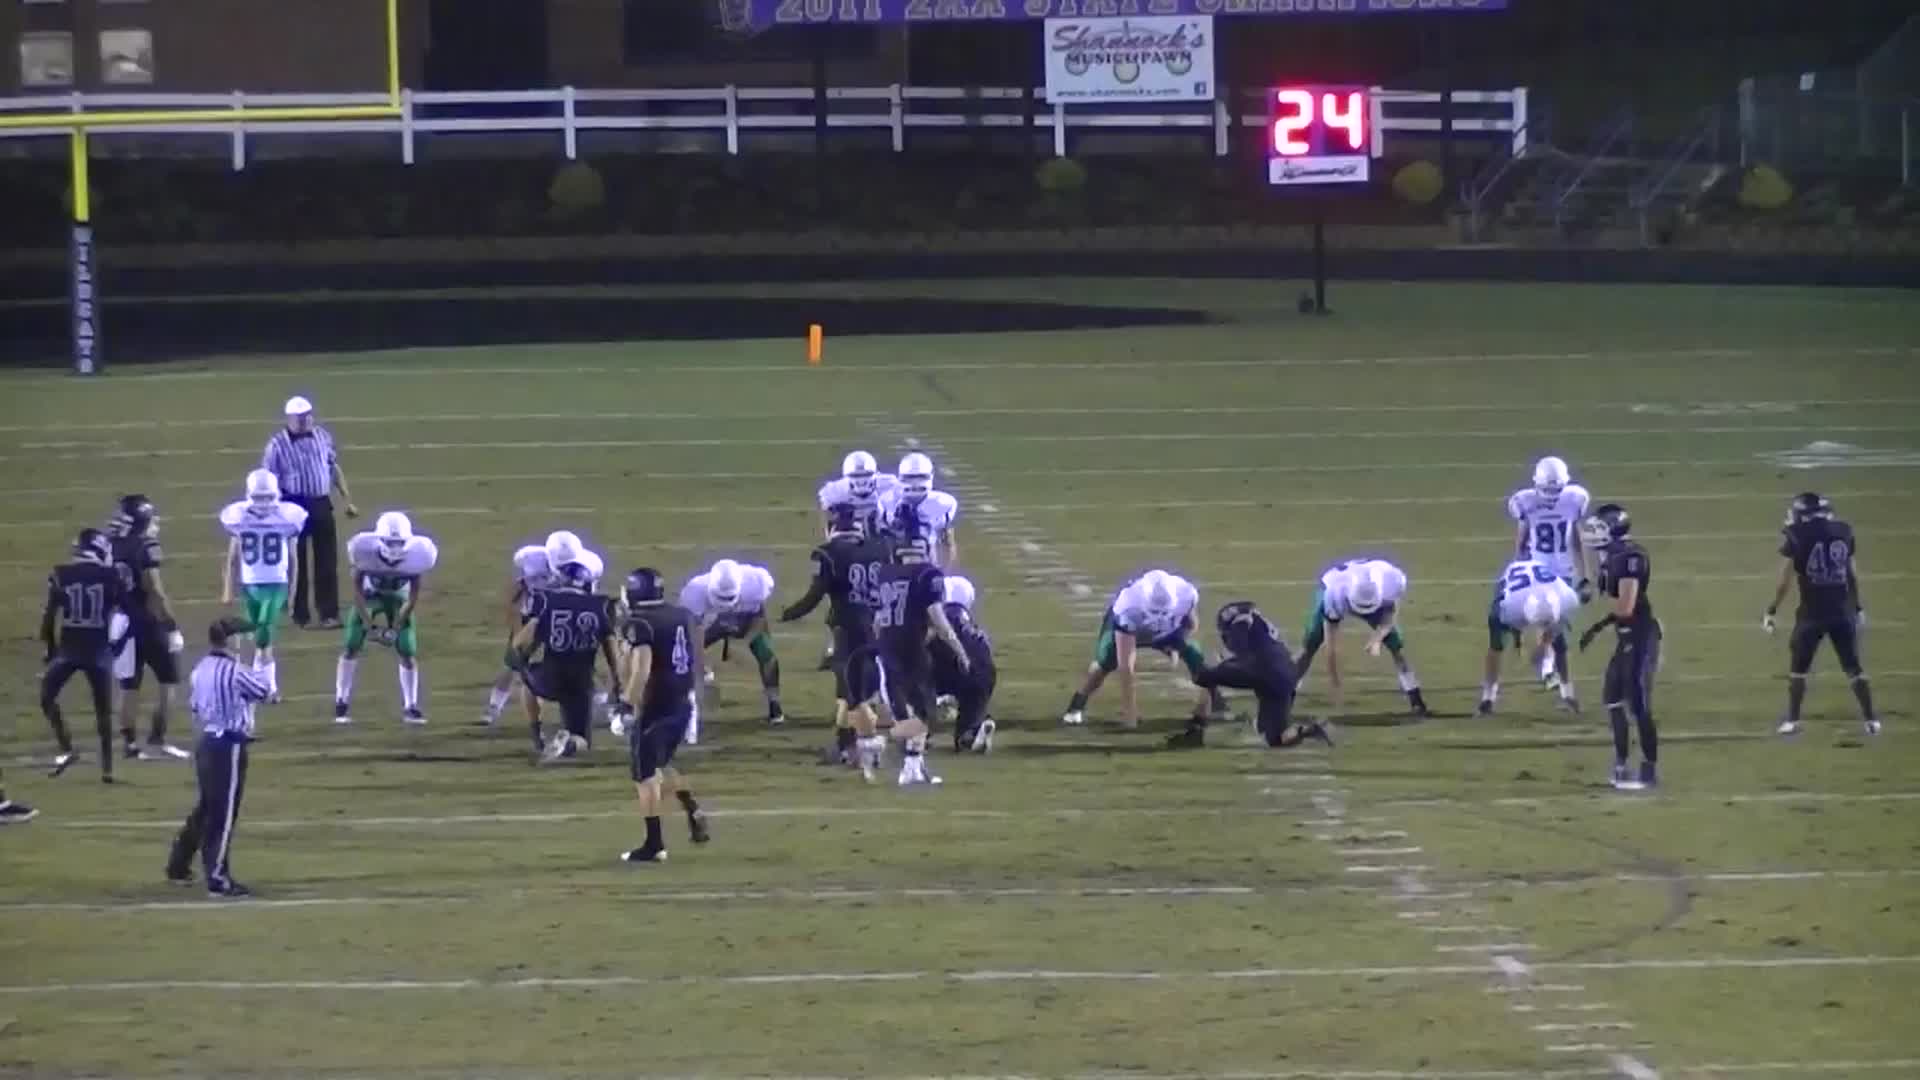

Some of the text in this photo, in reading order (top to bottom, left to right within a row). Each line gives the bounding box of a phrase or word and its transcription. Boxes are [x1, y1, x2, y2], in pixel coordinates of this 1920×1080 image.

[1141, 50, 1192, 64] PAWN
[1274, 90, 1362, 155] 24
[1536, 523, 1567, 552] 81
[64, 583, 104, 627] 11
[671, 625, 689, 674] 4
